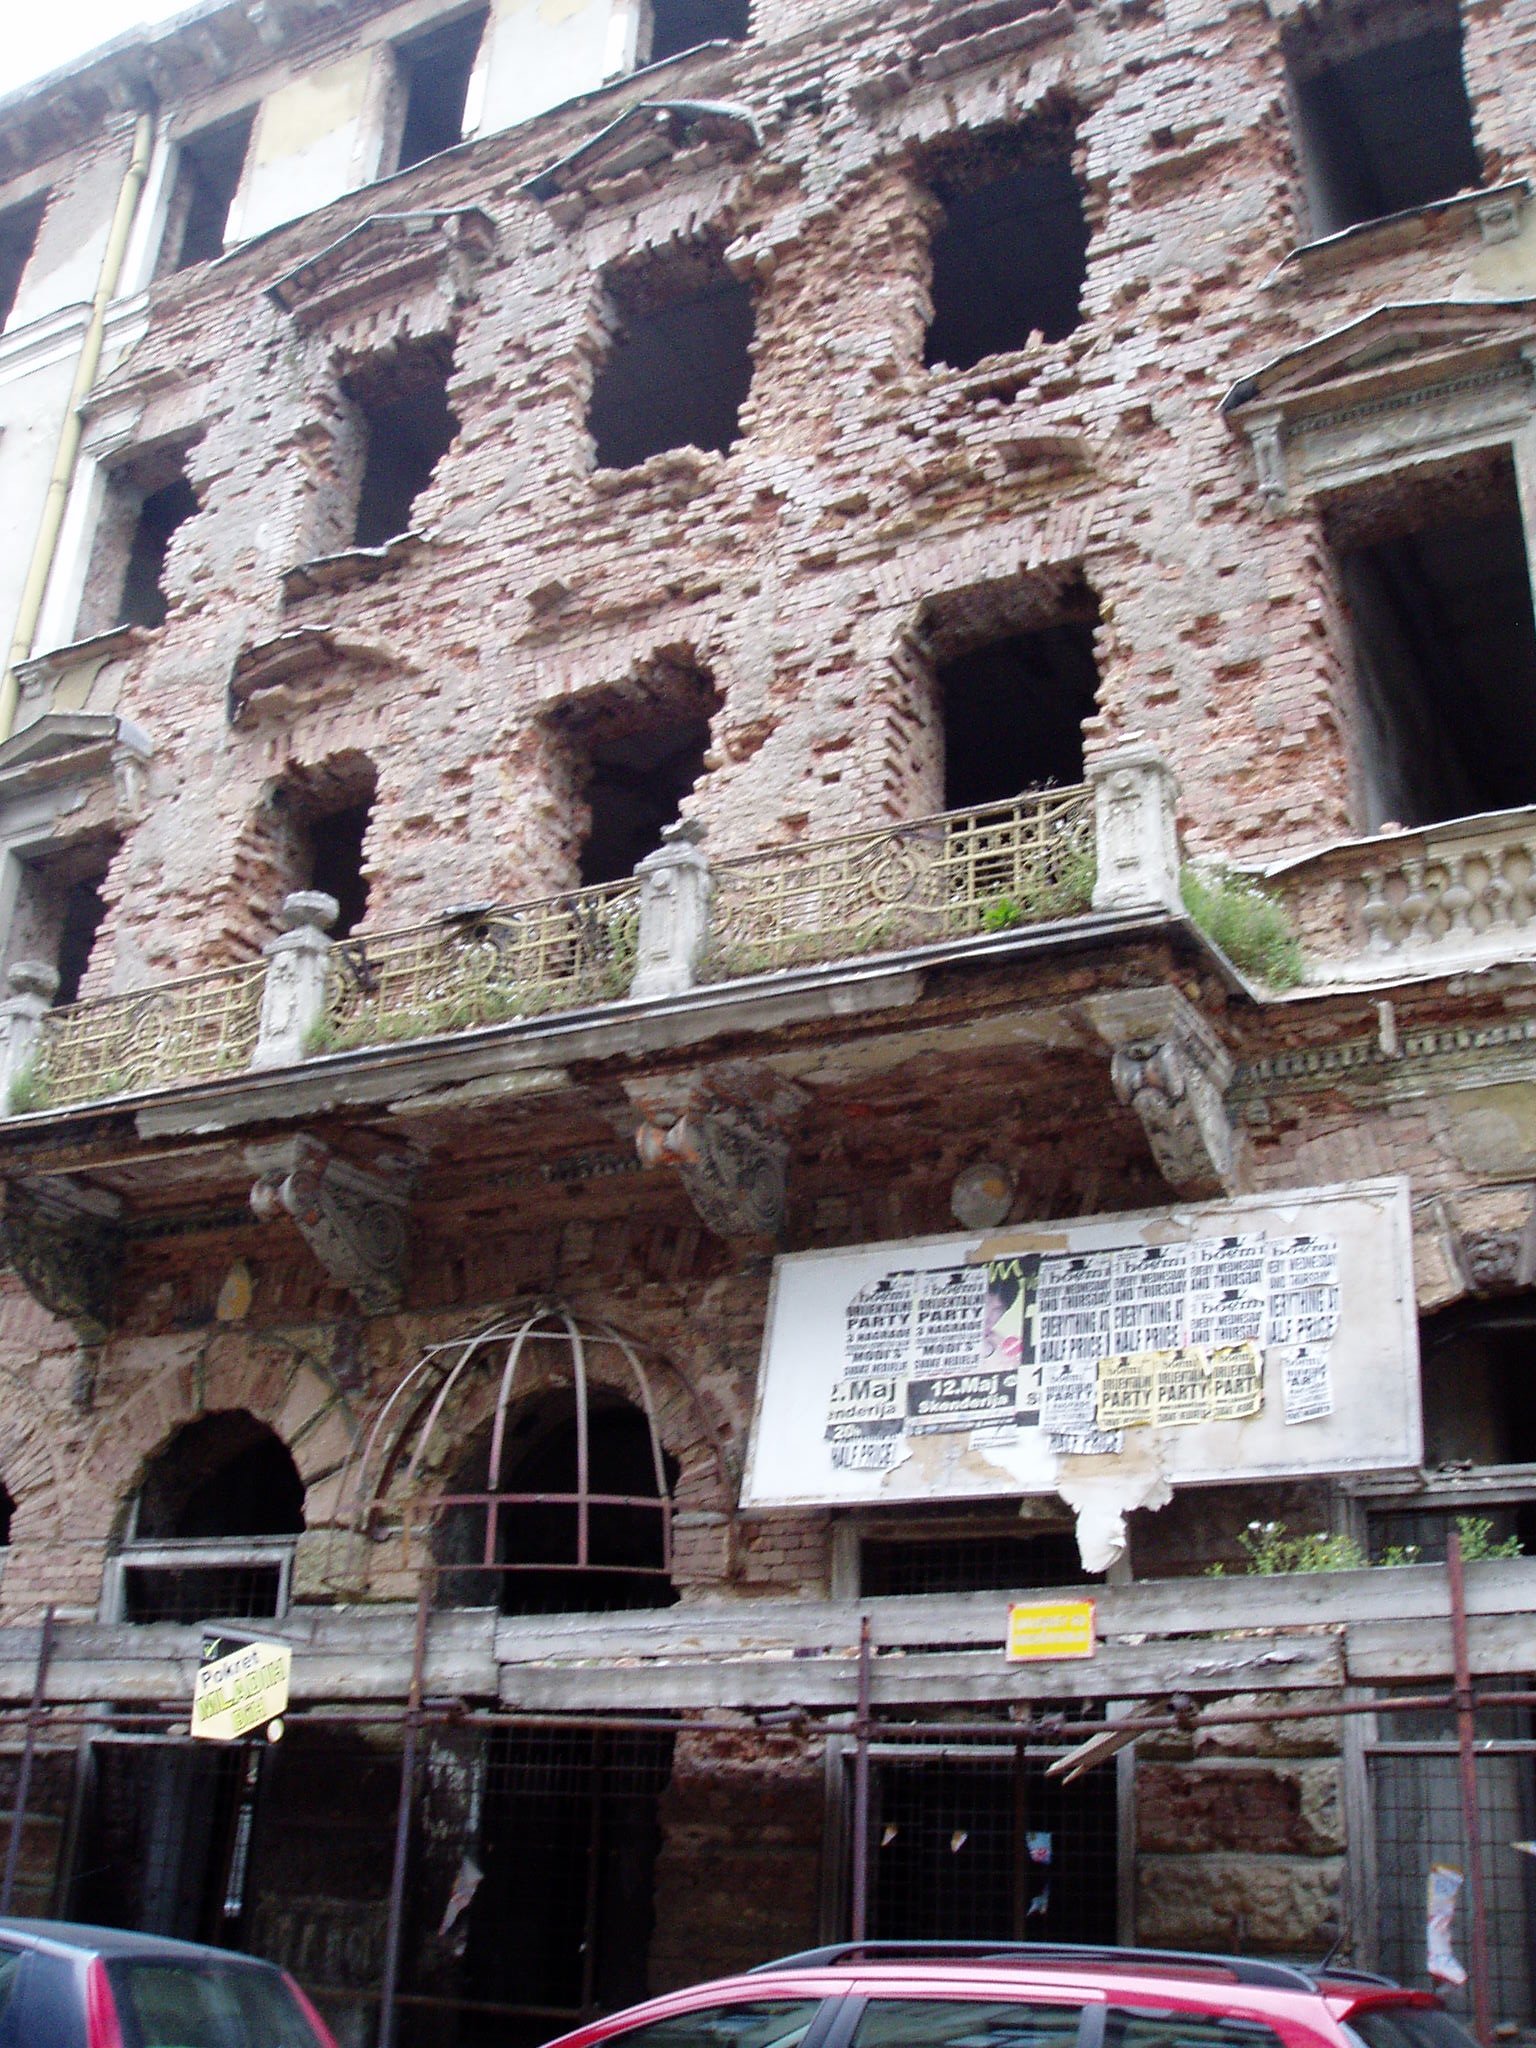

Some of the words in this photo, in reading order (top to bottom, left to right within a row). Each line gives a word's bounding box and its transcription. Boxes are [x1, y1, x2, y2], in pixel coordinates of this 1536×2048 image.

[847, 1313, 910, 1330] PARTY
[919, 1306, 983, 1323] PARTY
[1041, 1311, 1096, 1339] EVERYTHING
[1114, 1301, 1171, 1329] EVERYTHING
[1040, 1339, 1067, 1362] HALF
[1070, 1335, 1102, 1359] PRICE
[1114, 1329, 1141, 1353] HALF
[1146, 1324, 1178, 1350] PRICE
[930, 1373, 1000, 1397] 12.Maj
[1046, 1390, 1093, 1402] PARTY
[1158, 1383, 1207, 1402] PARTY
[1215, 1377, 1256, 1396] PART
[917, 1392, 1009, 1414] Skenderija
[1102, 1389, 1153, 1407] PARTY
[201, 1652, 259, 1689] Pokret
